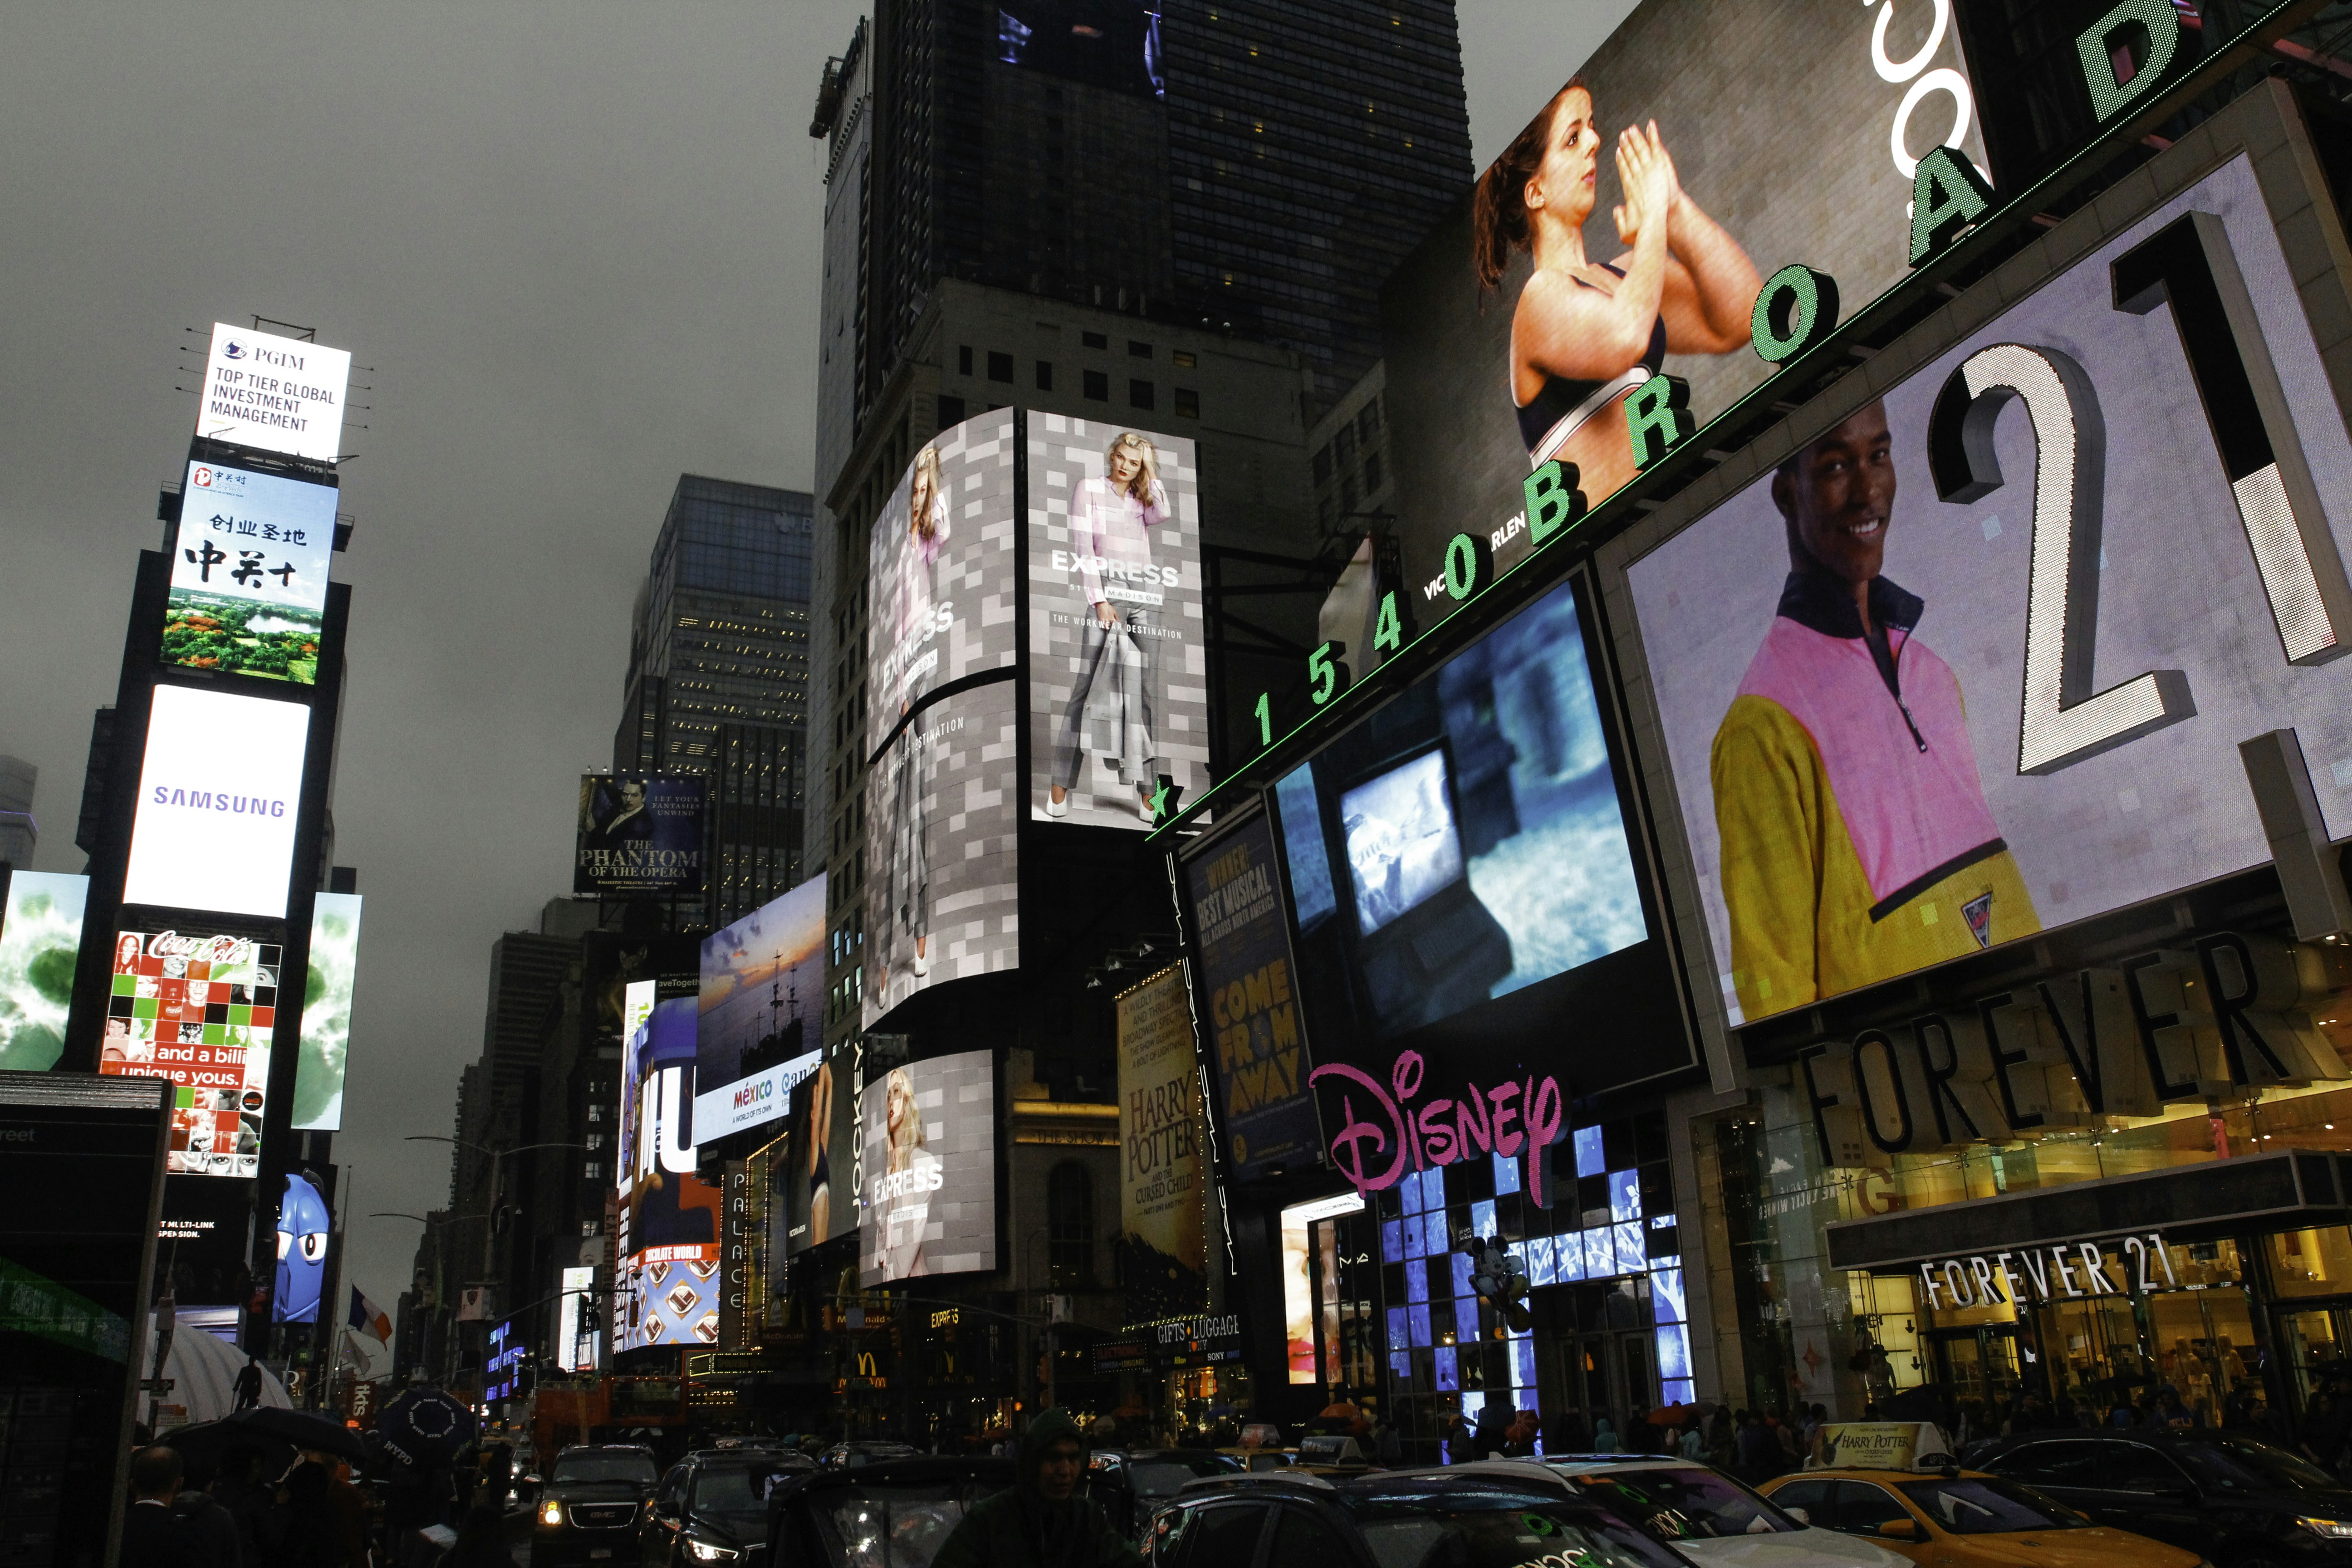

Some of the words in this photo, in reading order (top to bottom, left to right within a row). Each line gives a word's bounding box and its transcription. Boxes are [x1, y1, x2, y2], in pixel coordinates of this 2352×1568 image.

[255, 348, 305, 370] PGIM
[214, 384, 301, 413] INVESTMENT
[216, 368, 243, 383] TOP
[249, 374, 279, 392] TIER
[284, 382, 334, 404] GLOBAL
[211, 401, 308, 431] MANAGEMENT
[1927, 210, 2343, 776] 21
[209, 514, 307, 546] 创业圣地
[1052, 549, 1180, 587] EXPRESS
[1108, 590, 1160, 603] MADISON
[1054, 614, 1068, 624] THE
[1073, 617, 1122, 631] WORKWEAR
[1127, 624, 1181, 639] DESTINATION
[154, 786, 284, 817] SAMSUNG
[624, 840, 653, 850] THE
[579, 849, 699, 867] PHANTOM
[589, 867, 608, 877] OF
[611, 867, 638, 877] THE
[641, 867, 687, 878] OPERA
[1196, 891, 1221, 931] BEST
[1222, 863, 1272, 916] MUSICAL
[1213, 957, 1290, 1029] COME
[1133, 1011, 1147, 1025] AND
[1122, 1021, 1157, 1047] BROADWAY
[157, 1047, 194, 1062] and
[198, 1052, 210, 1063] a
[1130, 1046, 1139, 1056] THE
[1140, 1039, 1154, 1052] SHOW
[1150, 1050, 1156, 1061] OF
[1798, 931, 2291, 1166] FOREVER
[191, 1071, 239, 1086] yous.
[1229, 1046, 1299, 1118] AWAY
[735, 1113, 749, 1123] WORLD
[762, 1104, 772, 1113] OWN
[1129, 1070, 1192, 1134] HARRY
[1128, 1117, 1202, 1183] POTTER
[874, 1163, 943, 1205] EXPRESS
[1152, 1171, 1162, 1182] AND
[1163, 1168, 1172, 1178] THE
[1136, 1183, 1165, 1204] CURSED
[1167, 1174, 1193, 1195] CHILD
[1143, 1206, 1155, 1215] PARTS
[1156, 1204, 1164, 1212] ONE
[1165, 1201, 1174, 1210] AND
[1175, 1198, 1185, 1208] TWO
[645, 1247, 672, 1262] CHOCOLATE
[673, 1245, 702, 1259] WORLD
[730, 1174, 744, 1308] PALACE
[1921, 1243, 2114, 1310] FOREVER
[2124, 1234, 2176, 1290] 21
[837, 1315, 892, 1324] Mnald's
[1158, 1322, 1185, 1344] GIFTS
[1192, 1315, 1240, 1340] LUGGAGE
[1207, 1352, 1224, 1361] SONY
[353, 1384, 371, 1416] tkts
[383, 1441, 413, 1465] NYPD
[1842, 1436, 1874, 1448] HARRY
[1874, 1435, 1909, 1448] POTTER
[1929, 1455, 1946, 1465] 4P32
